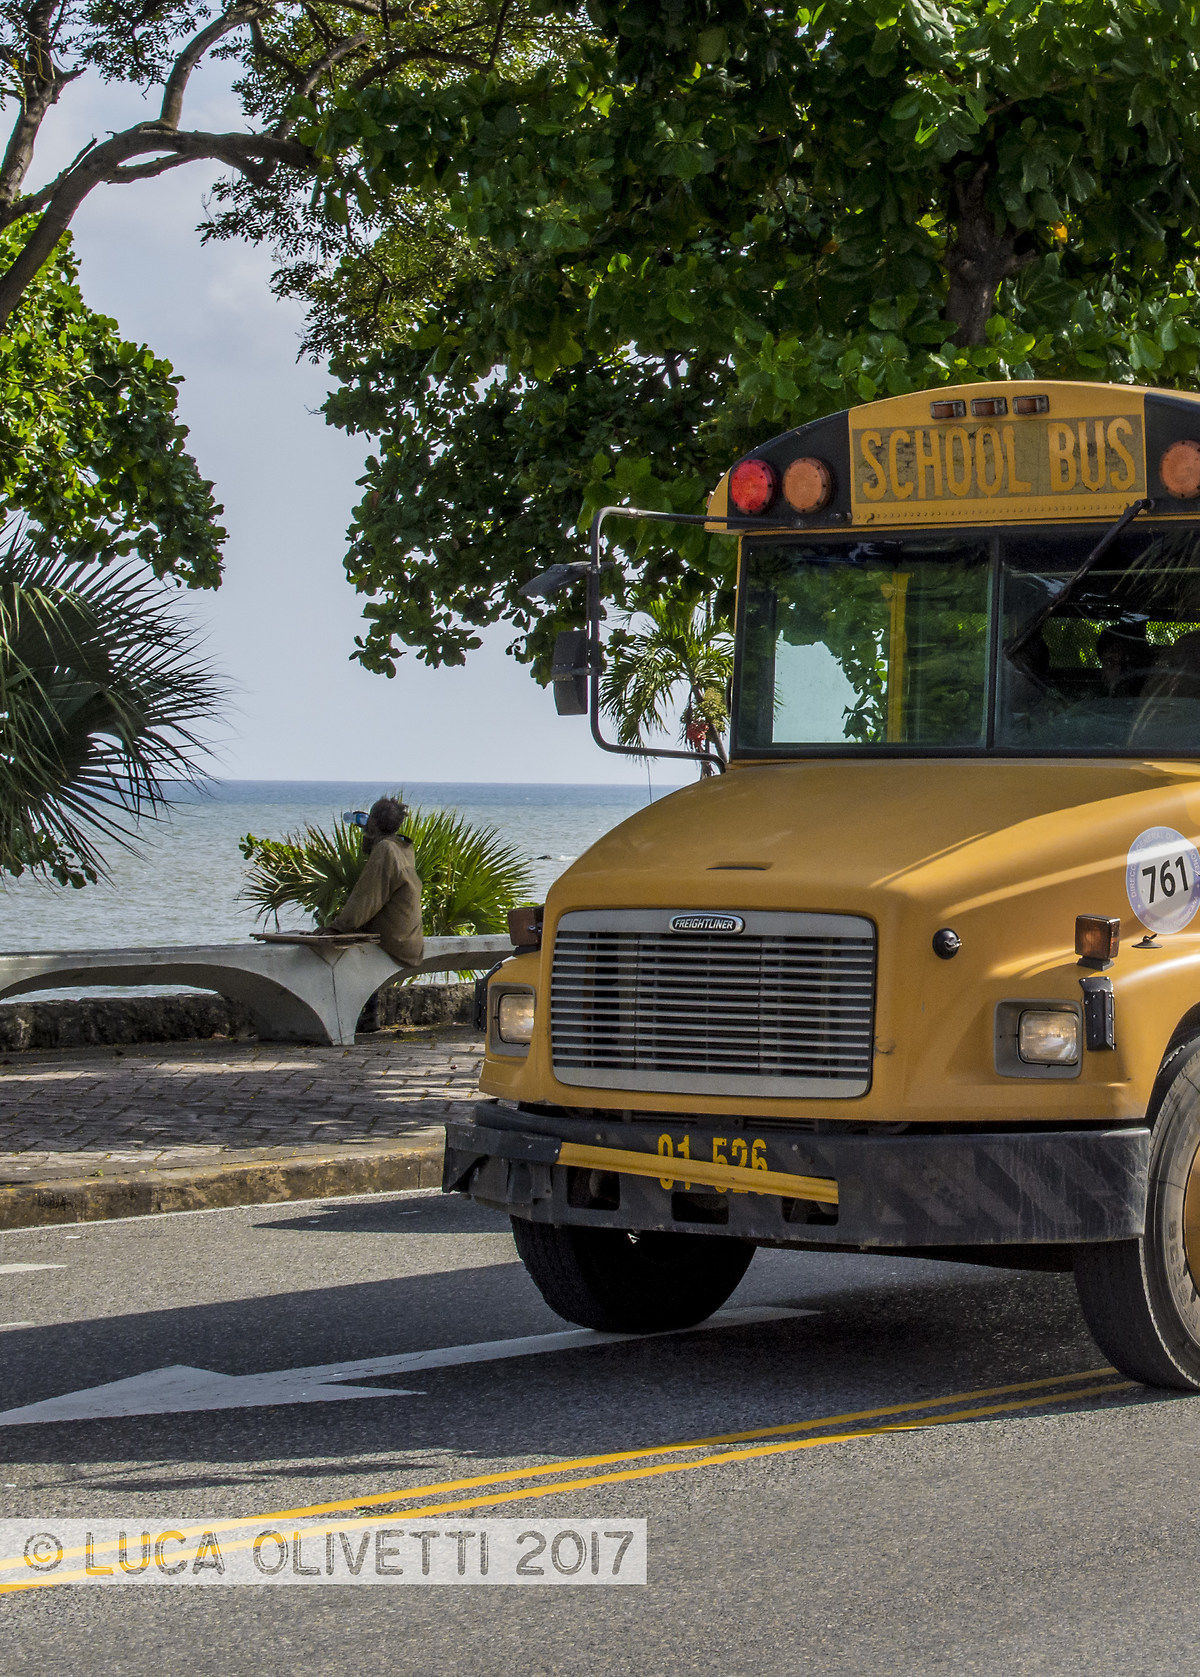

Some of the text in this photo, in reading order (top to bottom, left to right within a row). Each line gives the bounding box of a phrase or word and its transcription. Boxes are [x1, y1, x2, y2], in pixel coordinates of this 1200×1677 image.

[860, 416, 1136, 500] SCHOOL BUS
[1141, 855, 1190, 904] 761
[674, 918, 734, 930] FREIGHTLINER
